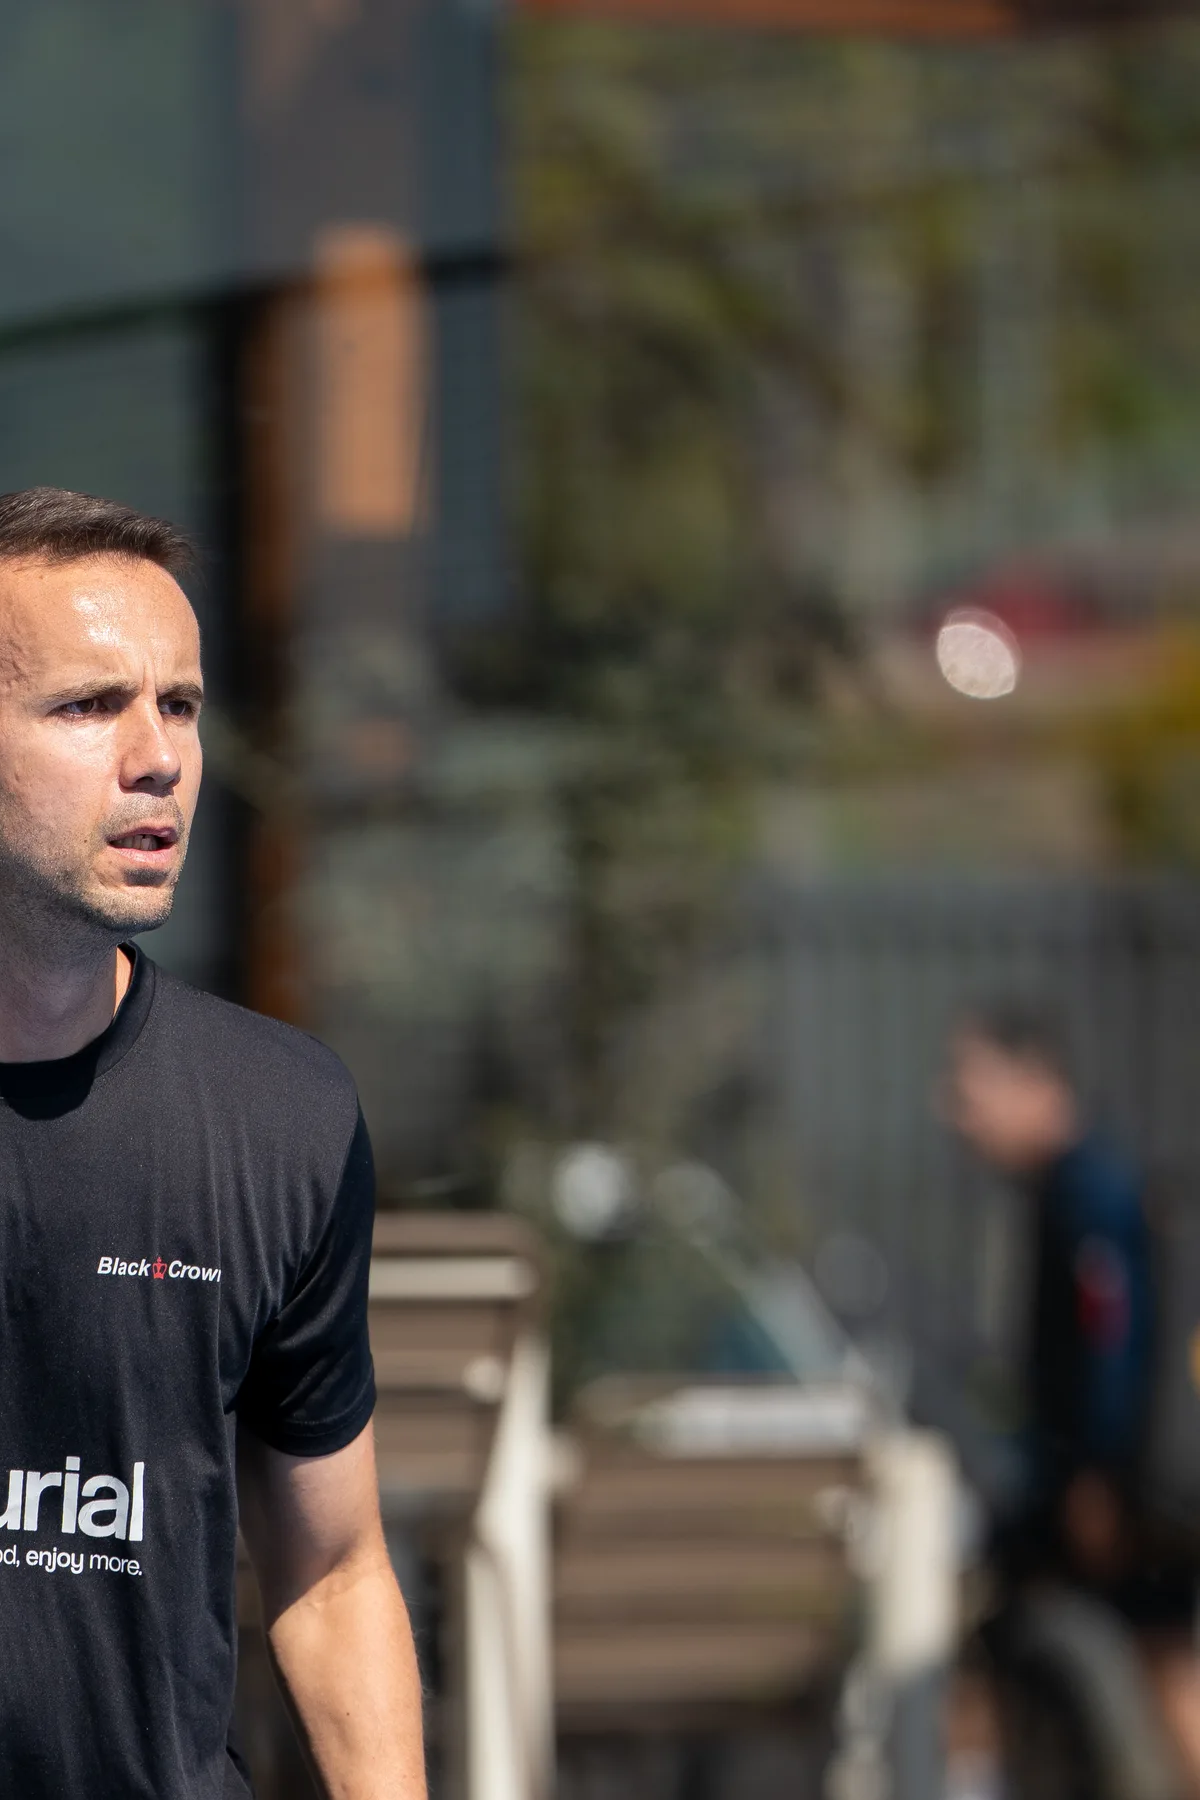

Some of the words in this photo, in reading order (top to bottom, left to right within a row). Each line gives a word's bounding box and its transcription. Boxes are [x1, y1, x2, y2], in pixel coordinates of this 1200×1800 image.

[96, 1256, 152, 1277] Black
[25, 1546, 85, 1576] enjoy
[89, 1553, 144, 1577] more.
